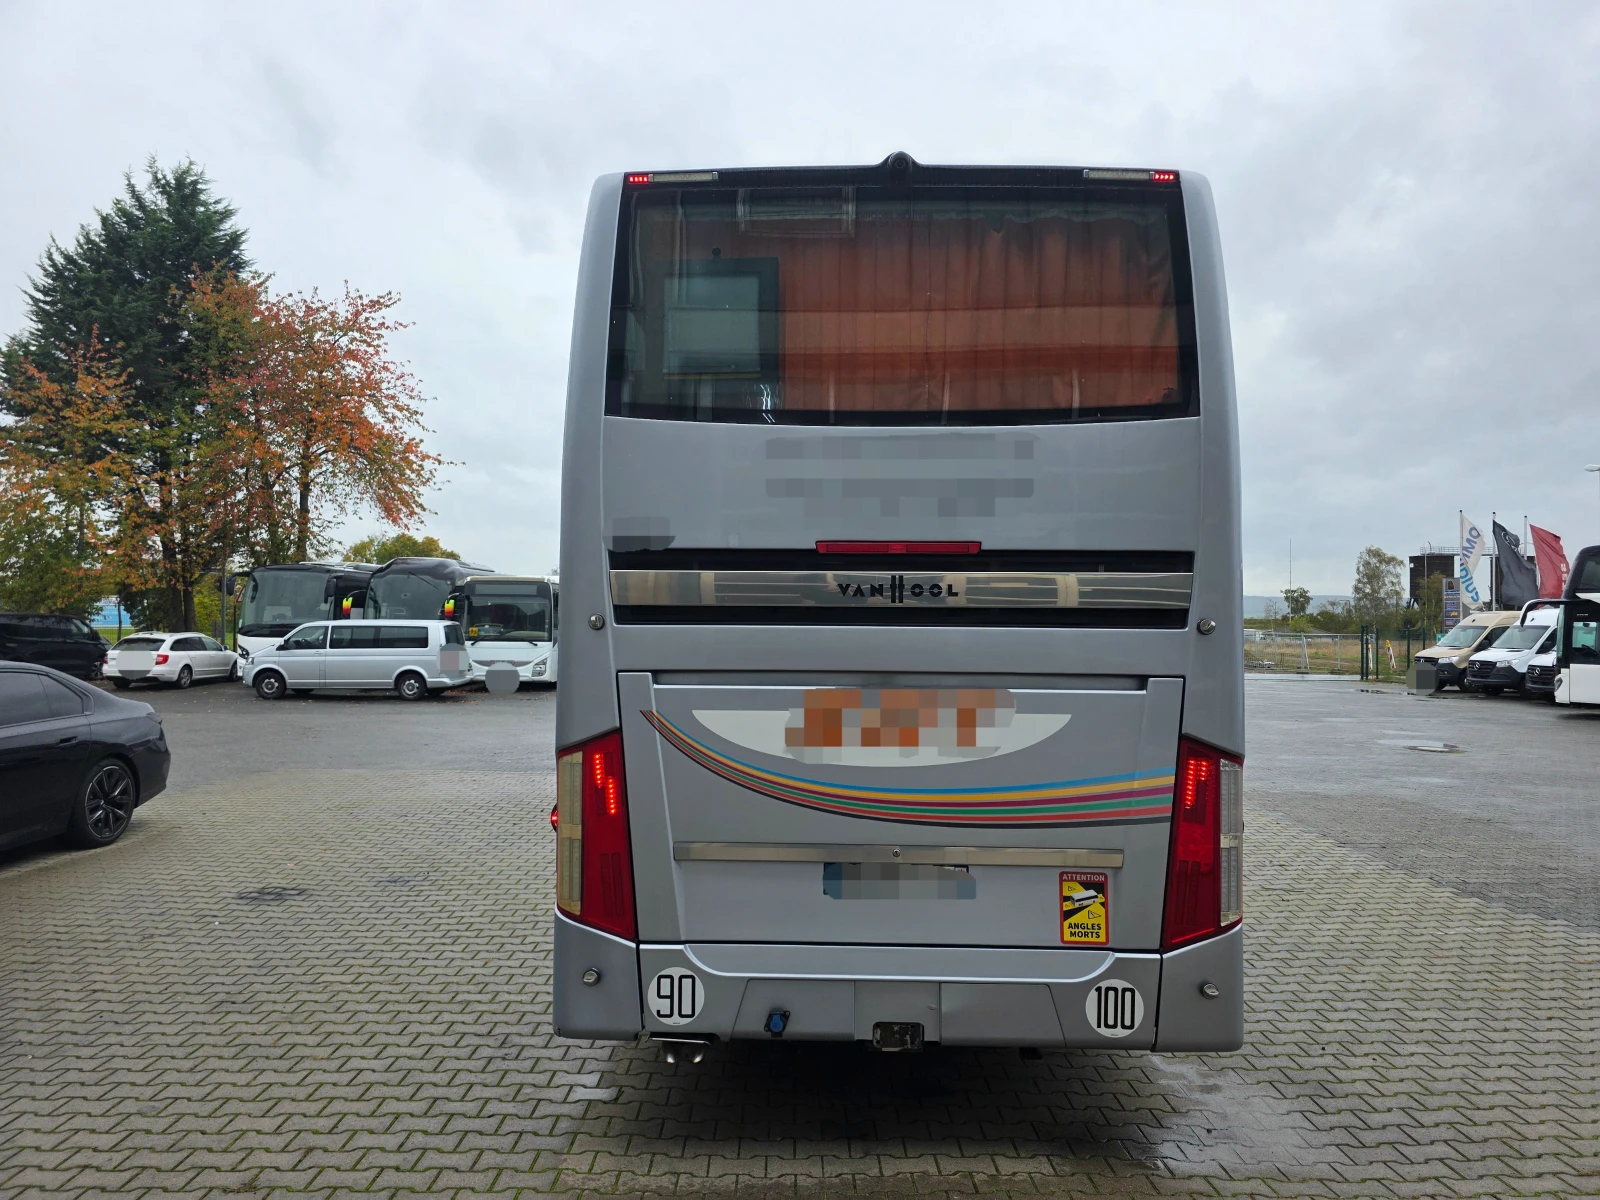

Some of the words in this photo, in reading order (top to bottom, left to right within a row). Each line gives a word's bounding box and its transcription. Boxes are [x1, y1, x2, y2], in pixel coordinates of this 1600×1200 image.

[1062, 873, 1105, 882] ATTENTION
[1067, 922, 1102, 931] ANGLES
[1069, 930, 1101, 939] MORTS
[656, 974, 696, 1019] 90
[1094, 985, 1136, 1030] 100
